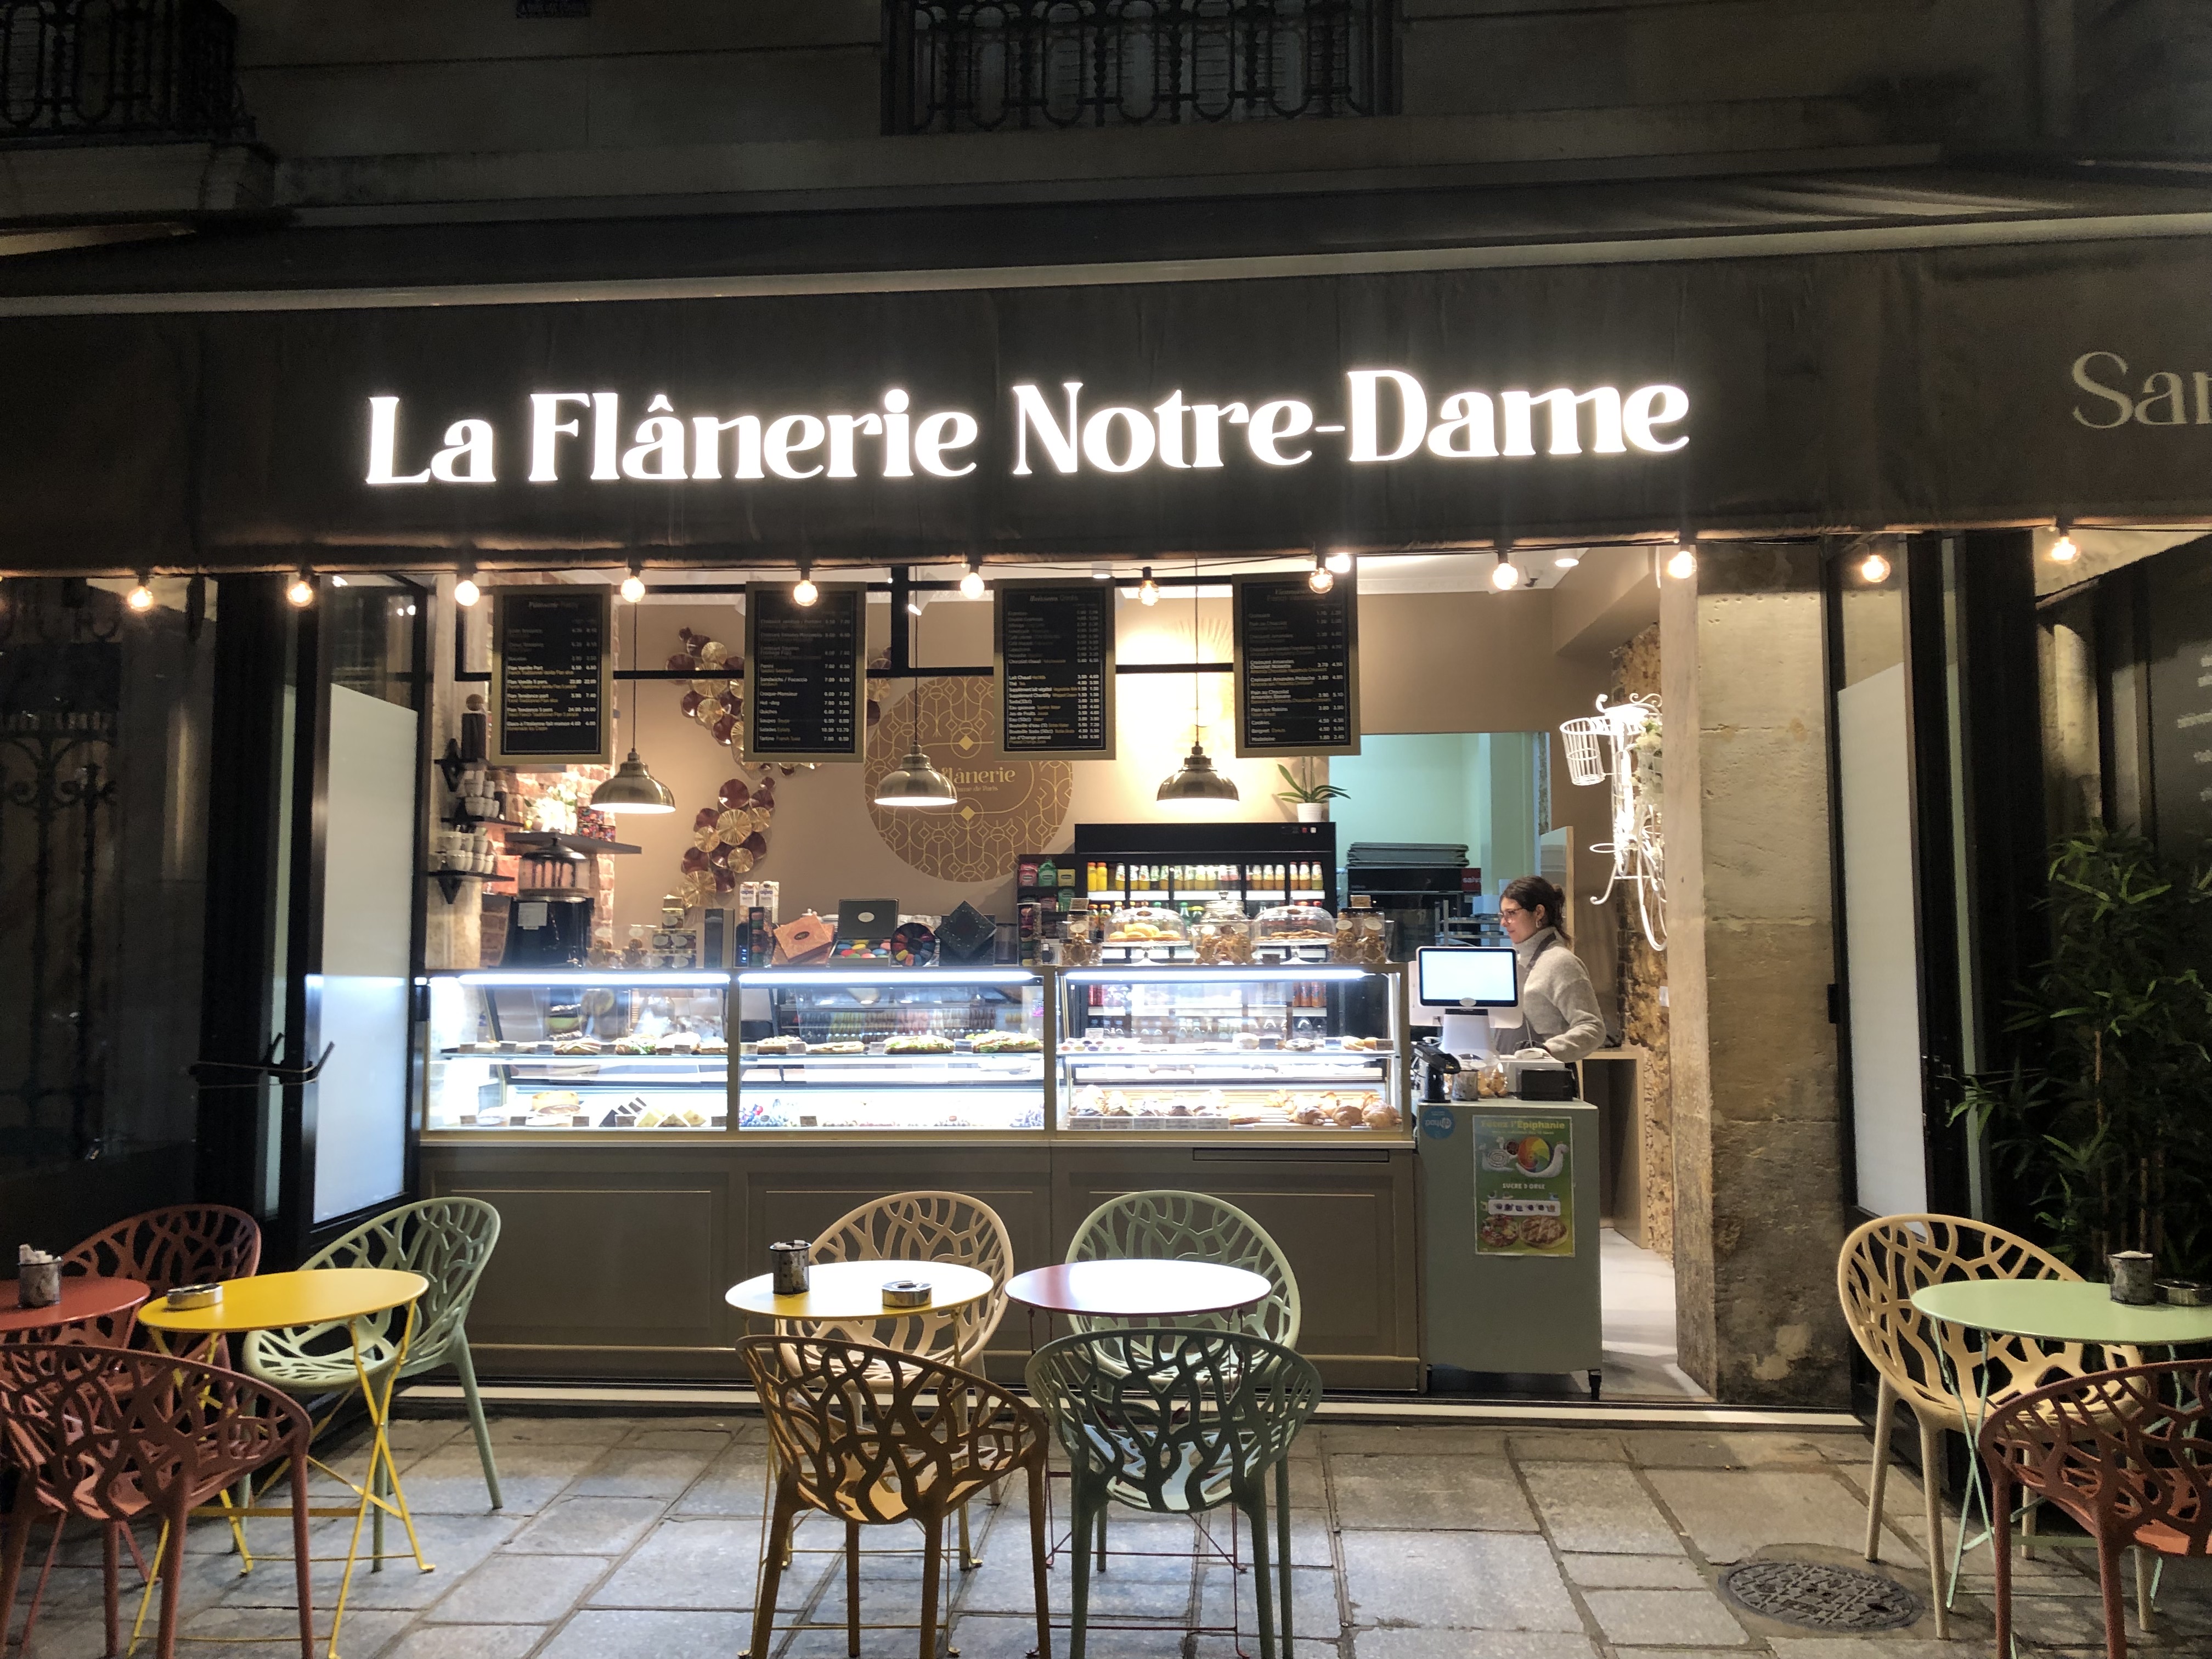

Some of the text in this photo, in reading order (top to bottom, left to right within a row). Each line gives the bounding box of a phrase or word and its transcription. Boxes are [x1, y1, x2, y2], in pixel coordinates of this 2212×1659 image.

[365, 370, 1690, 485] La Flânerie Notre-Dame
